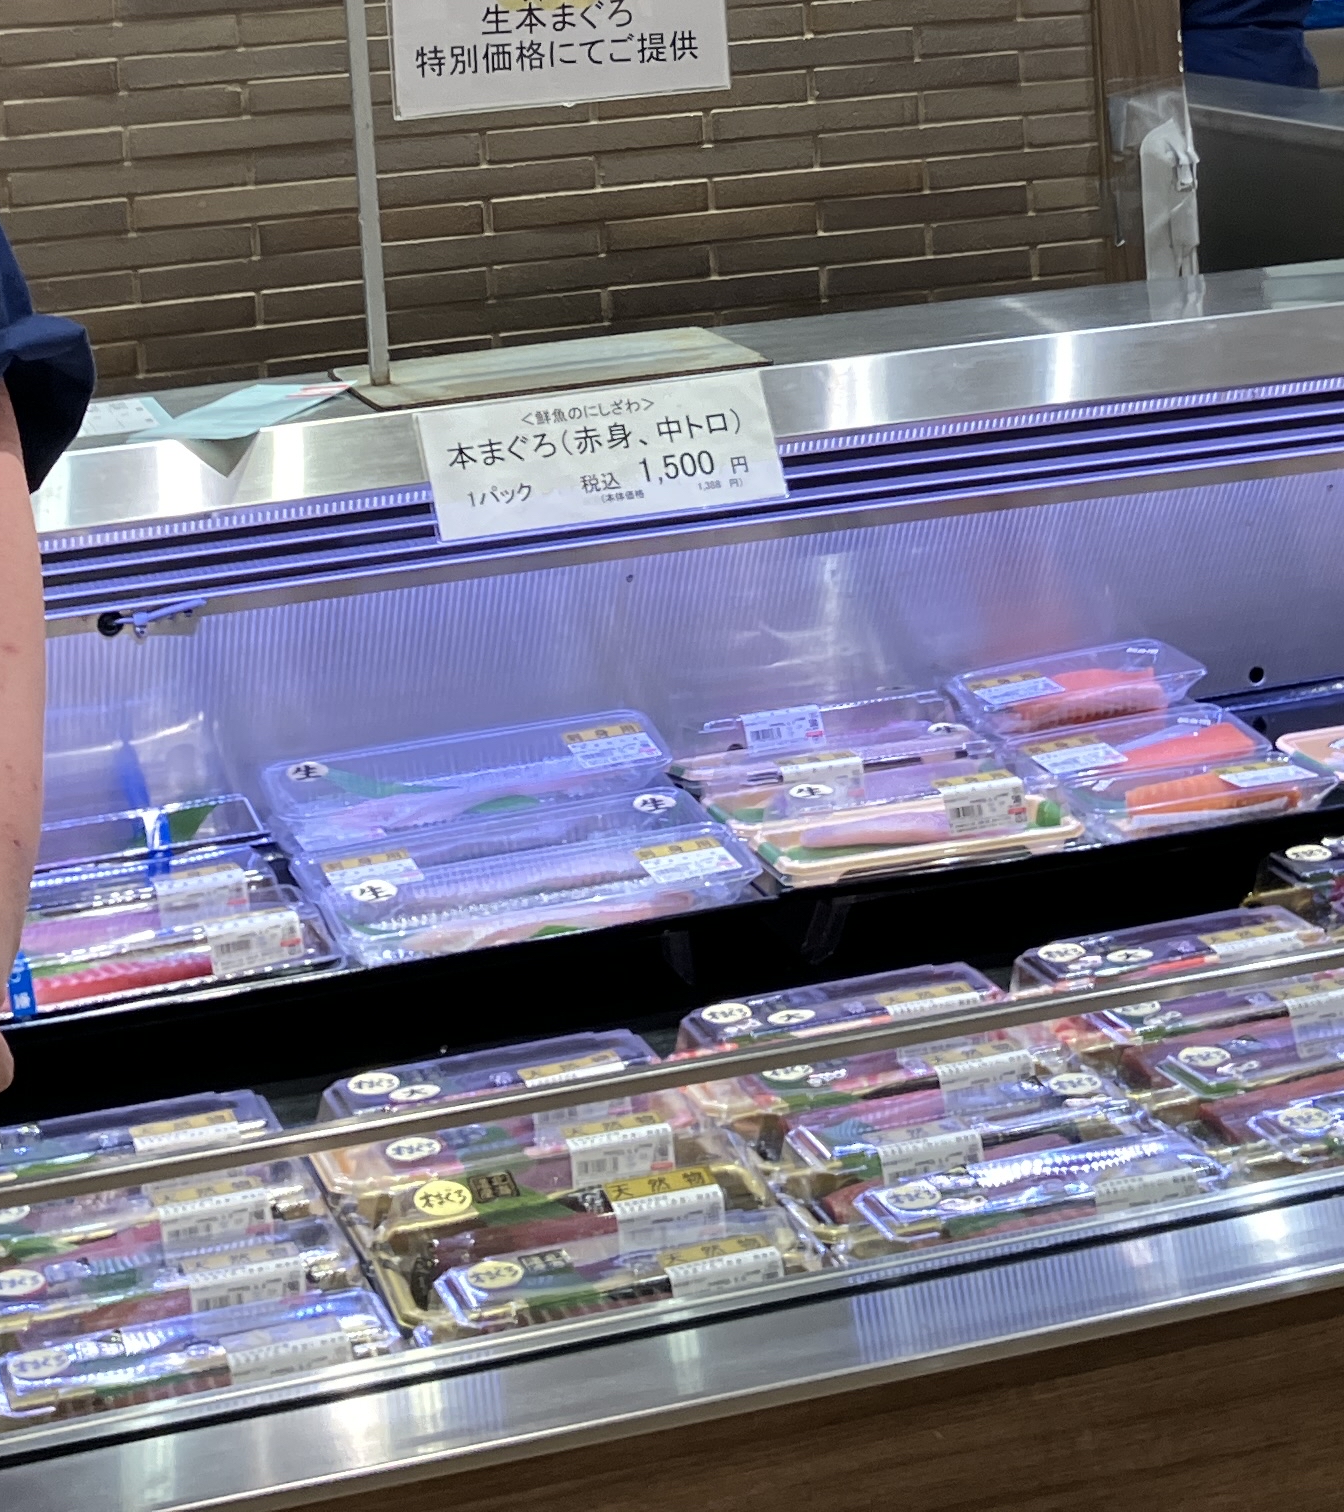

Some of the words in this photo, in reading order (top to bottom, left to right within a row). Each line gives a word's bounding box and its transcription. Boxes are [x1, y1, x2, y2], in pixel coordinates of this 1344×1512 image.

[415, 30, 699, 78] 特別価格にてご提供
[467, 482, 533, 508] 1パック
[580, 472, 622, 495] 税込
[639, 450, 716, 485] 1,500
[730, 455, 750, 475] 円
